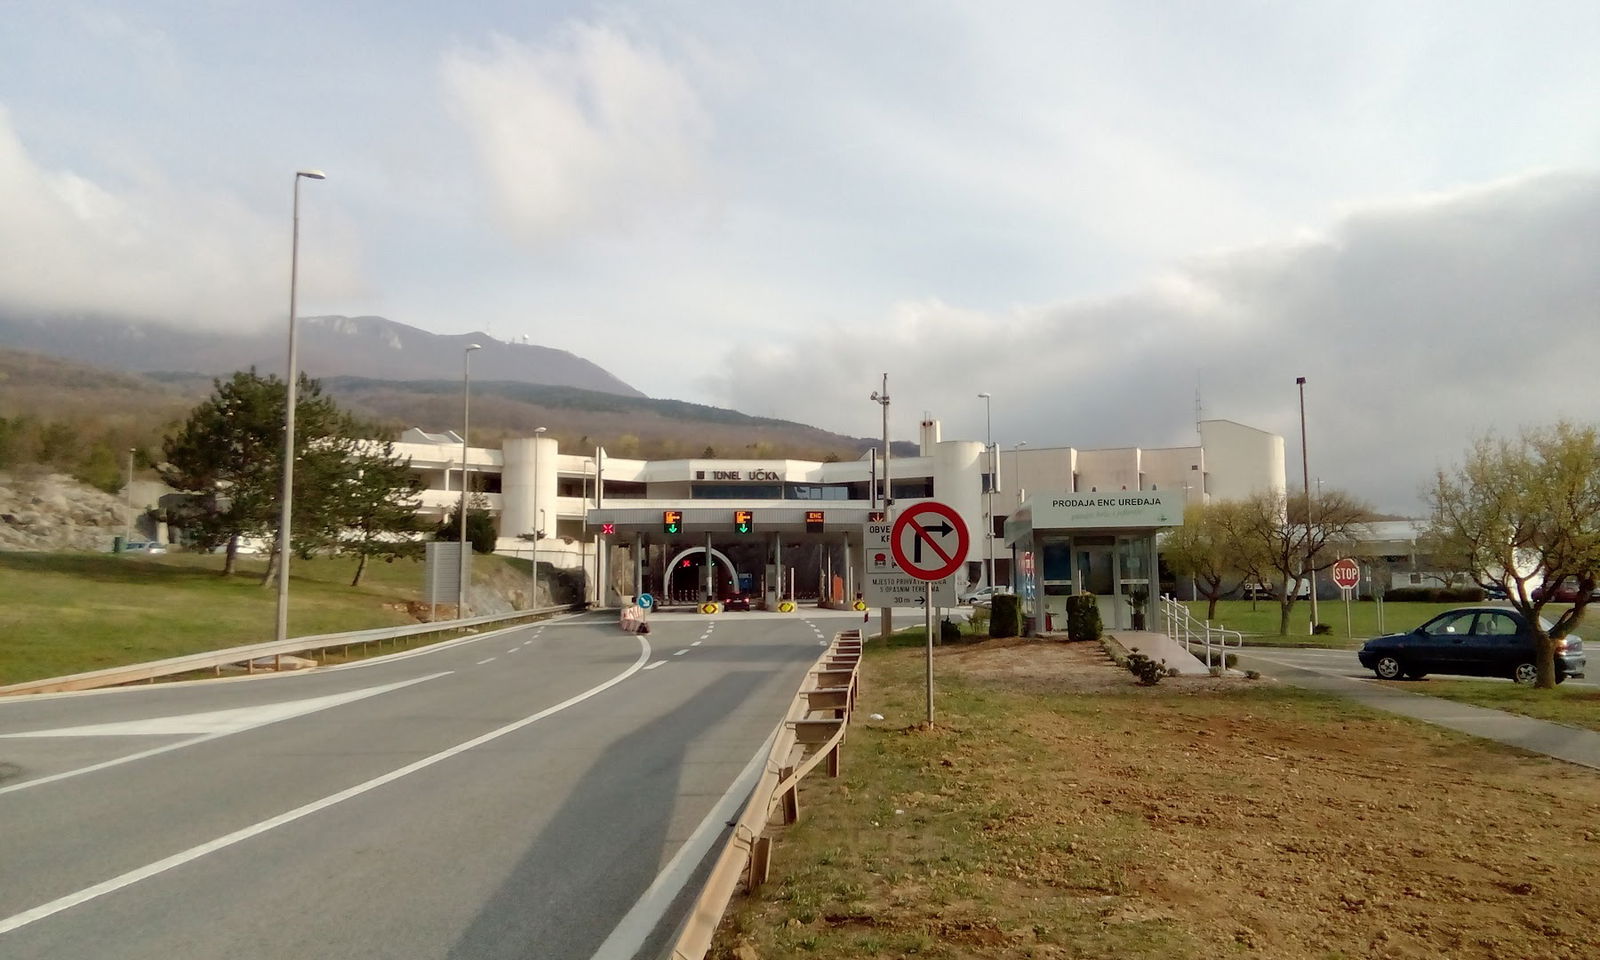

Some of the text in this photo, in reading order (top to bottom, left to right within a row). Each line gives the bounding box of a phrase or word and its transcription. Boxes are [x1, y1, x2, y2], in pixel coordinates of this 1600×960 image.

[712, 468, 780, 481] TUNEL UČKA
[1052, 497, 1162, 508] PRODAJA ENC UREĐAJA
[869, 525, 890, 533] OBVE
[1336, 567, 1357, 580] STOP
[884, 585, 910, 593] OPASNIM
[894, 596, 903, 604] 30
